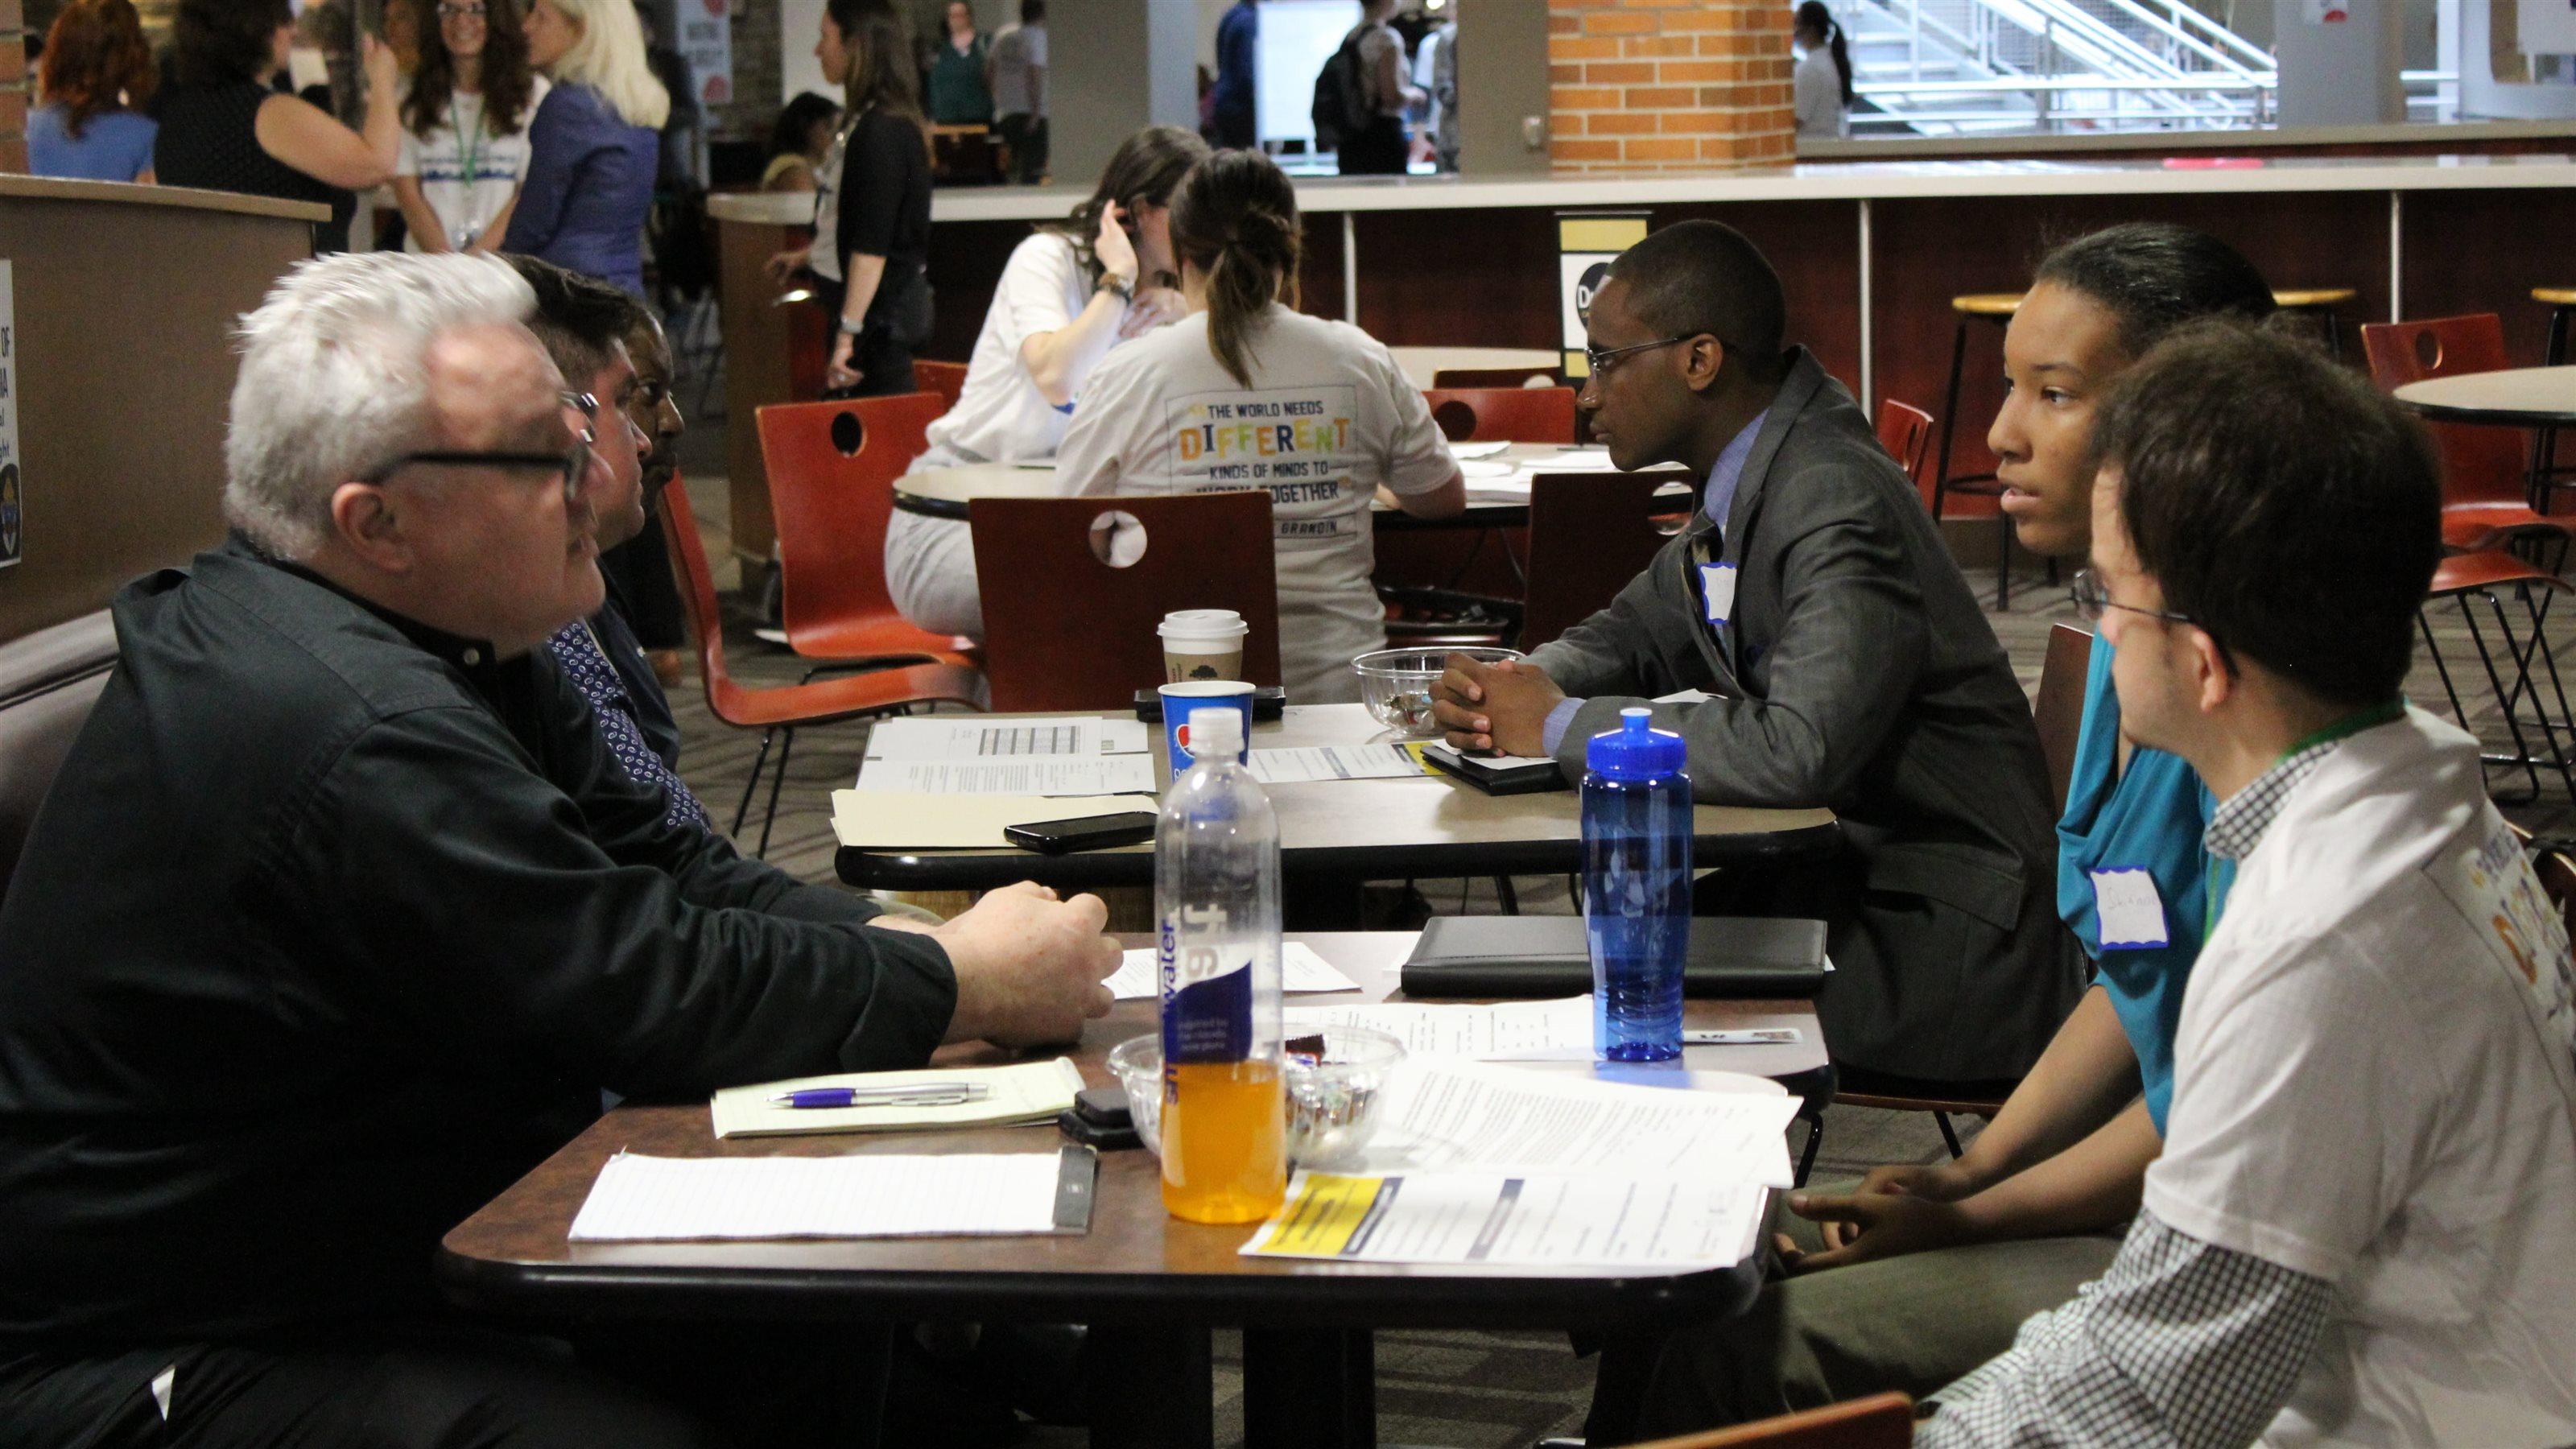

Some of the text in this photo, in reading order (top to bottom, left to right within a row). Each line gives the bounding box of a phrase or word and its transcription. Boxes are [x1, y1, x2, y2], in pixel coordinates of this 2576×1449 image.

[1208, 401, 1323, 419] THE WORLD NEEDS
[1179, 418, 1351, 460] DIFFERENT
[1210, 460, 1329, 480] KINDS OF MINDS TO
[1258, 482, 1340, 504] OGETHER
